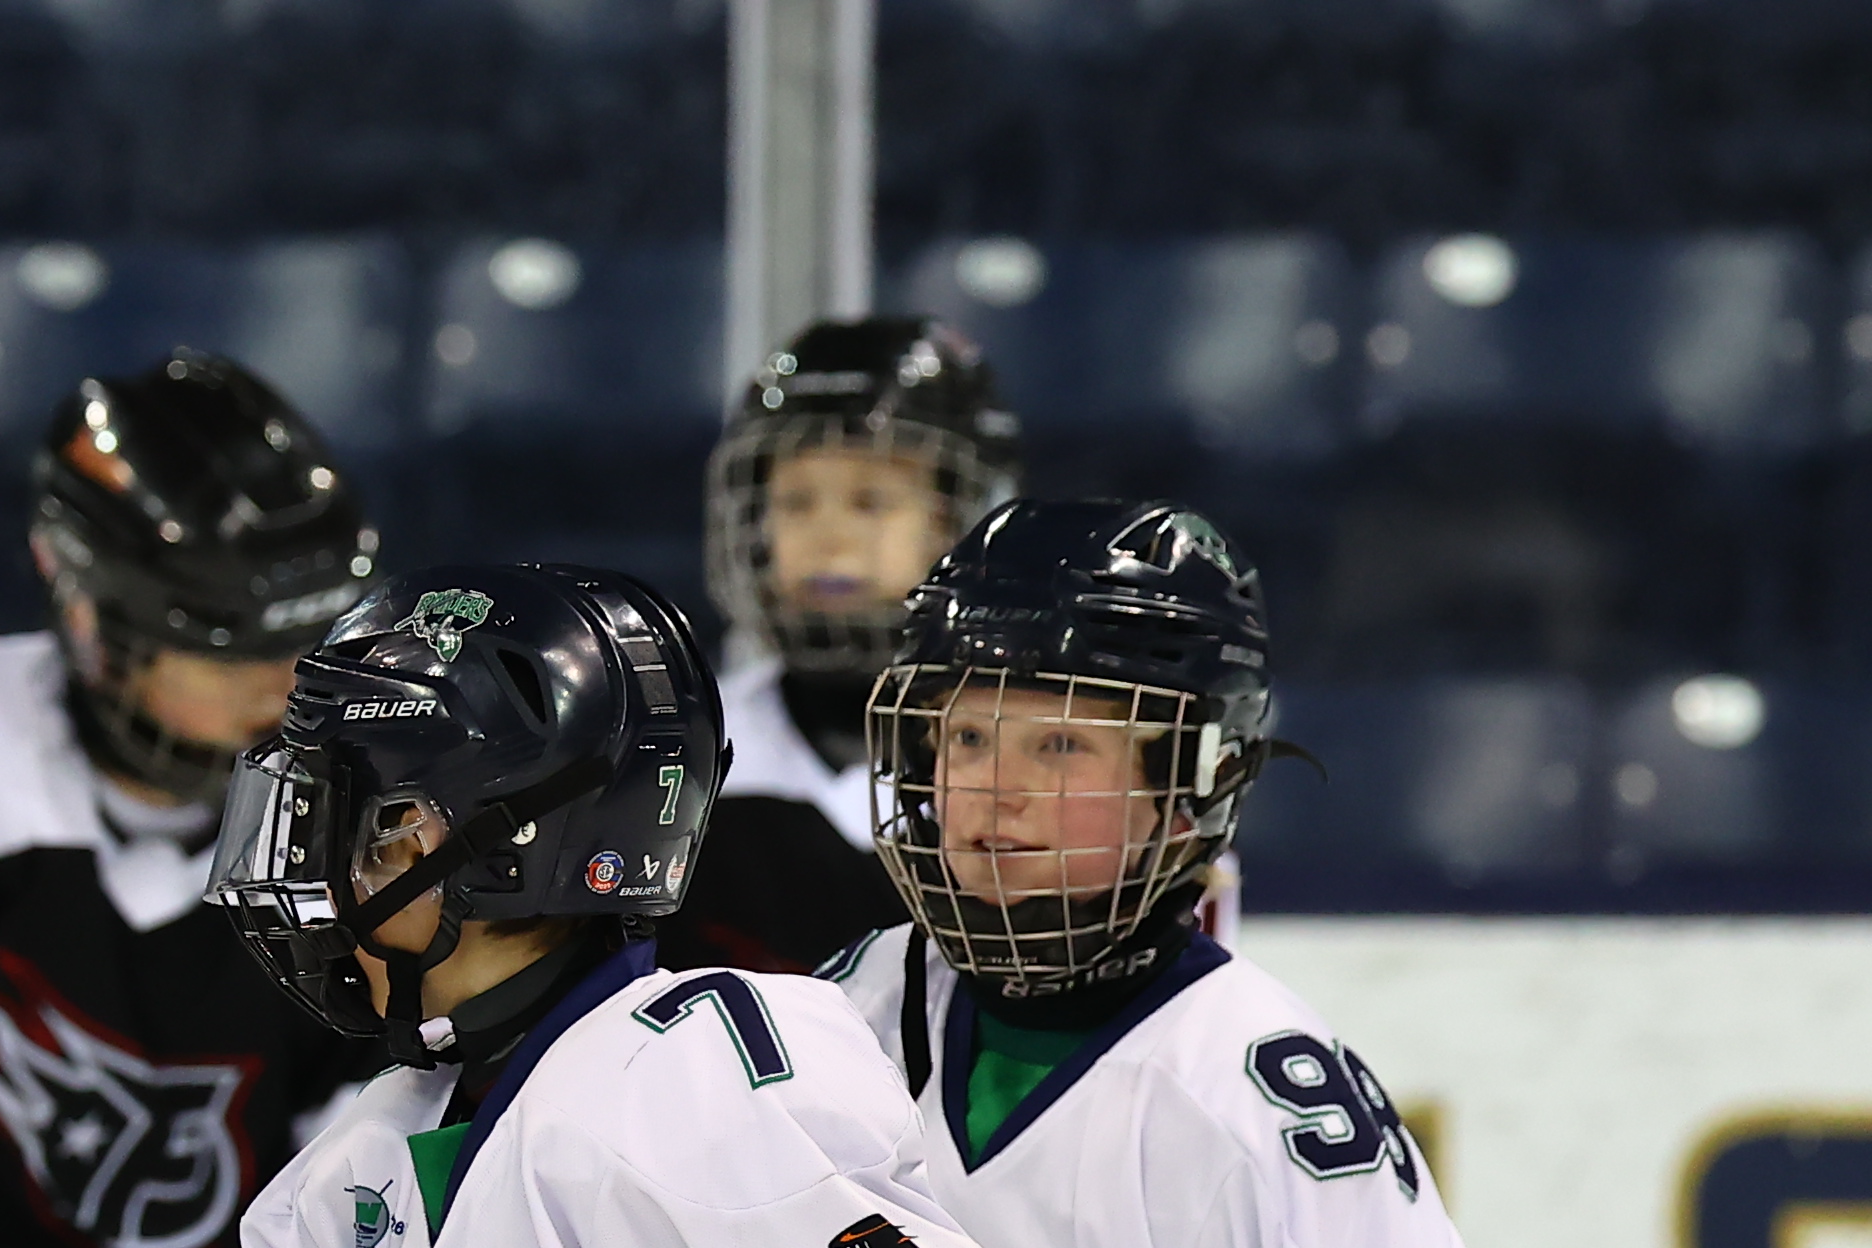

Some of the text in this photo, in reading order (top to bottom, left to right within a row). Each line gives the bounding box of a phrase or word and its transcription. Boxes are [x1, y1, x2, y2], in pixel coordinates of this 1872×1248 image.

[342, 699, 437, 721] BAUER
[659, 765, 684, 825] 7
[618, 885, 662, 896] BAUER
[630, 970, 795, 1090] 7
